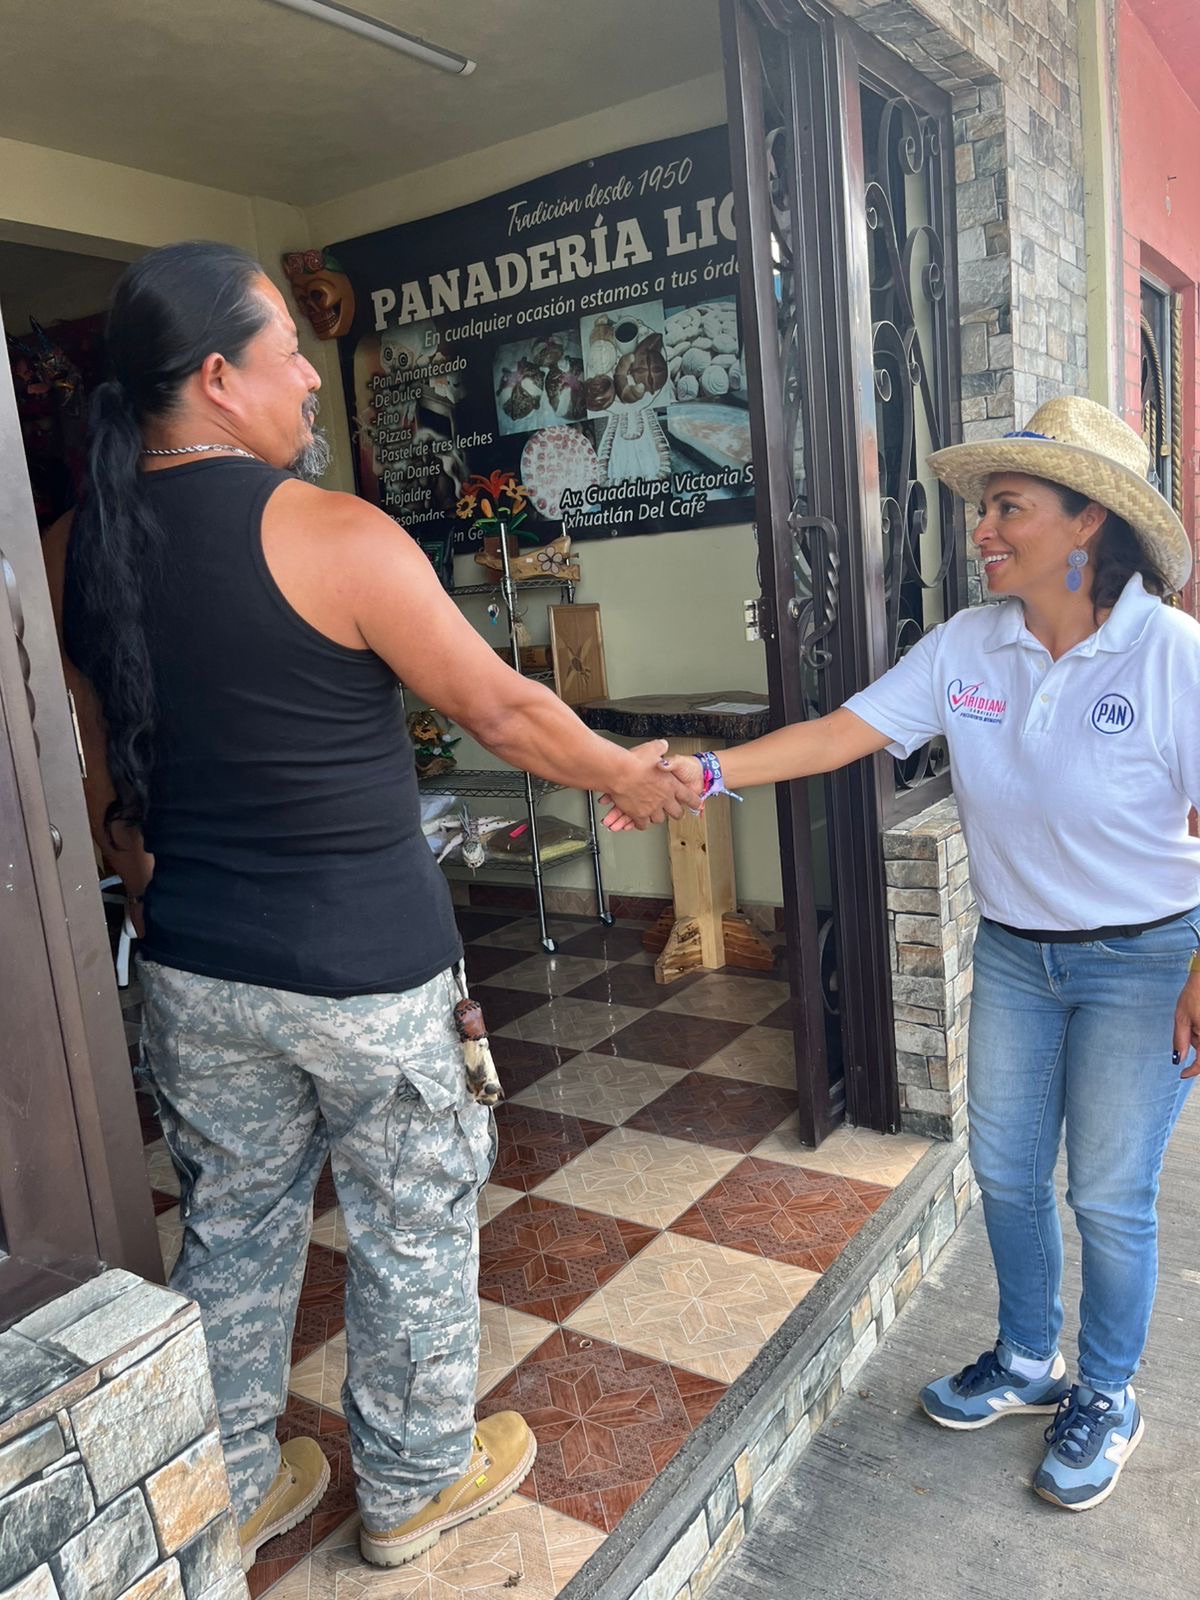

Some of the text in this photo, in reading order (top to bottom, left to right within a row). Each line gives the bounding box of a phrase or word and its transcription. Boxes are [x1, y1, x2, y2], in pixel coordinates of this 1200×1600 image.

[507, 157, 693, 237] Tradición desde 1950
[371, 213, 653, 332] PANADERÍA
[425, 330, 441, 347] En
[445, 313, 512, 342] cualquier
[516, 293, 575, 325] ocasión
[580, 280, 649, 309] estamos
[655, 277, 665, 292] a
[671, 268, 698, 289] tus
[394, 355, 467, 384] Amantecado
[392, 386, 422, 404] Dulce
[416, 442, 429, 456] de
[432, 439, 453, 454] tres
[456, 432, 493, 449] leches
[407, 460, 441, 479] Danés
[561, 490, 583, 508] Av.
[586, 480, 670, 504] Guadalupe
[675, 469, 738, 492] Victoria
[563, 494, 706, 529] Ixhuatlán Del Café
[1096, 703, 1127, 726] PAN
